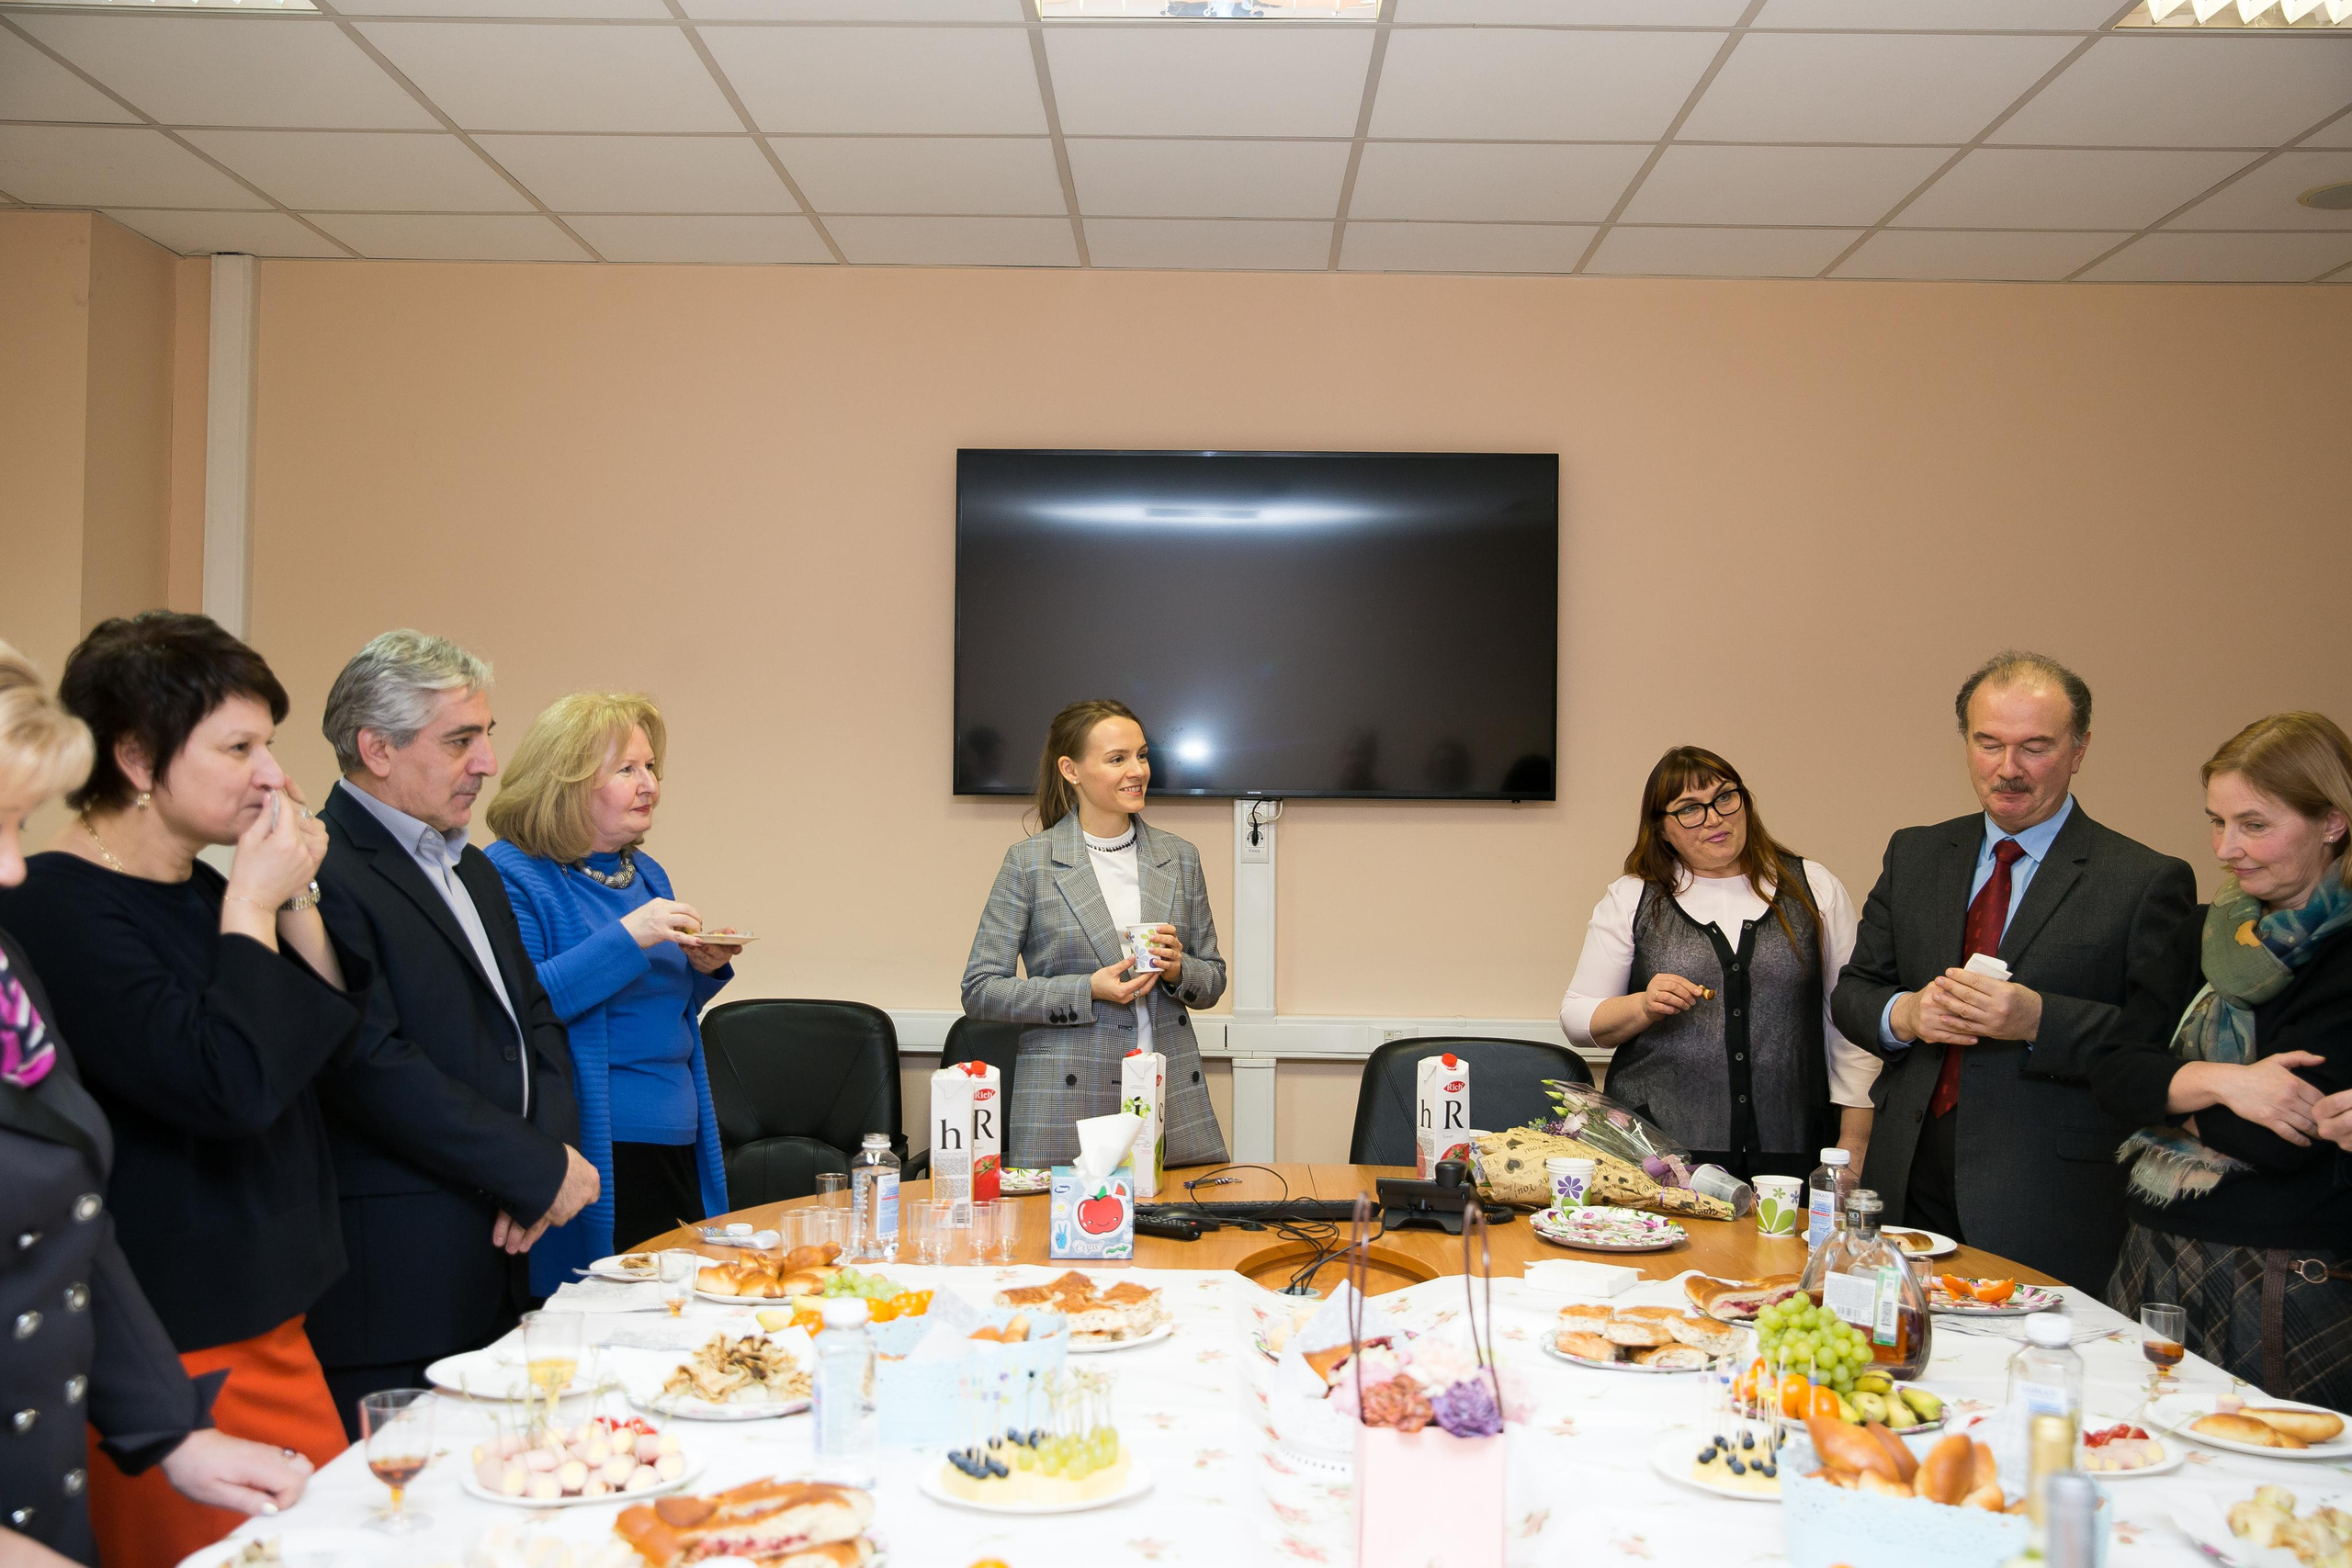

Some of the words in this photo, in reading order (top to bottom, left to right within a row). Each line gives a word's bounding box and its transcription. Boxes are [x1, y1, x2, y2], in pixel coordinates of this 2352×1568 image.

[974, 1089, 992, 1100] Rich
[1446, 1082, 1464, 1091] Rich
[974, 1109, 995, 1140] R
[1419, 1099, 1432, 1130] h
[1443, 1100, 1464, 1130] R
[940, 1119, 963, 1150] h
[1849, 1211, 1860, 1219] XO
